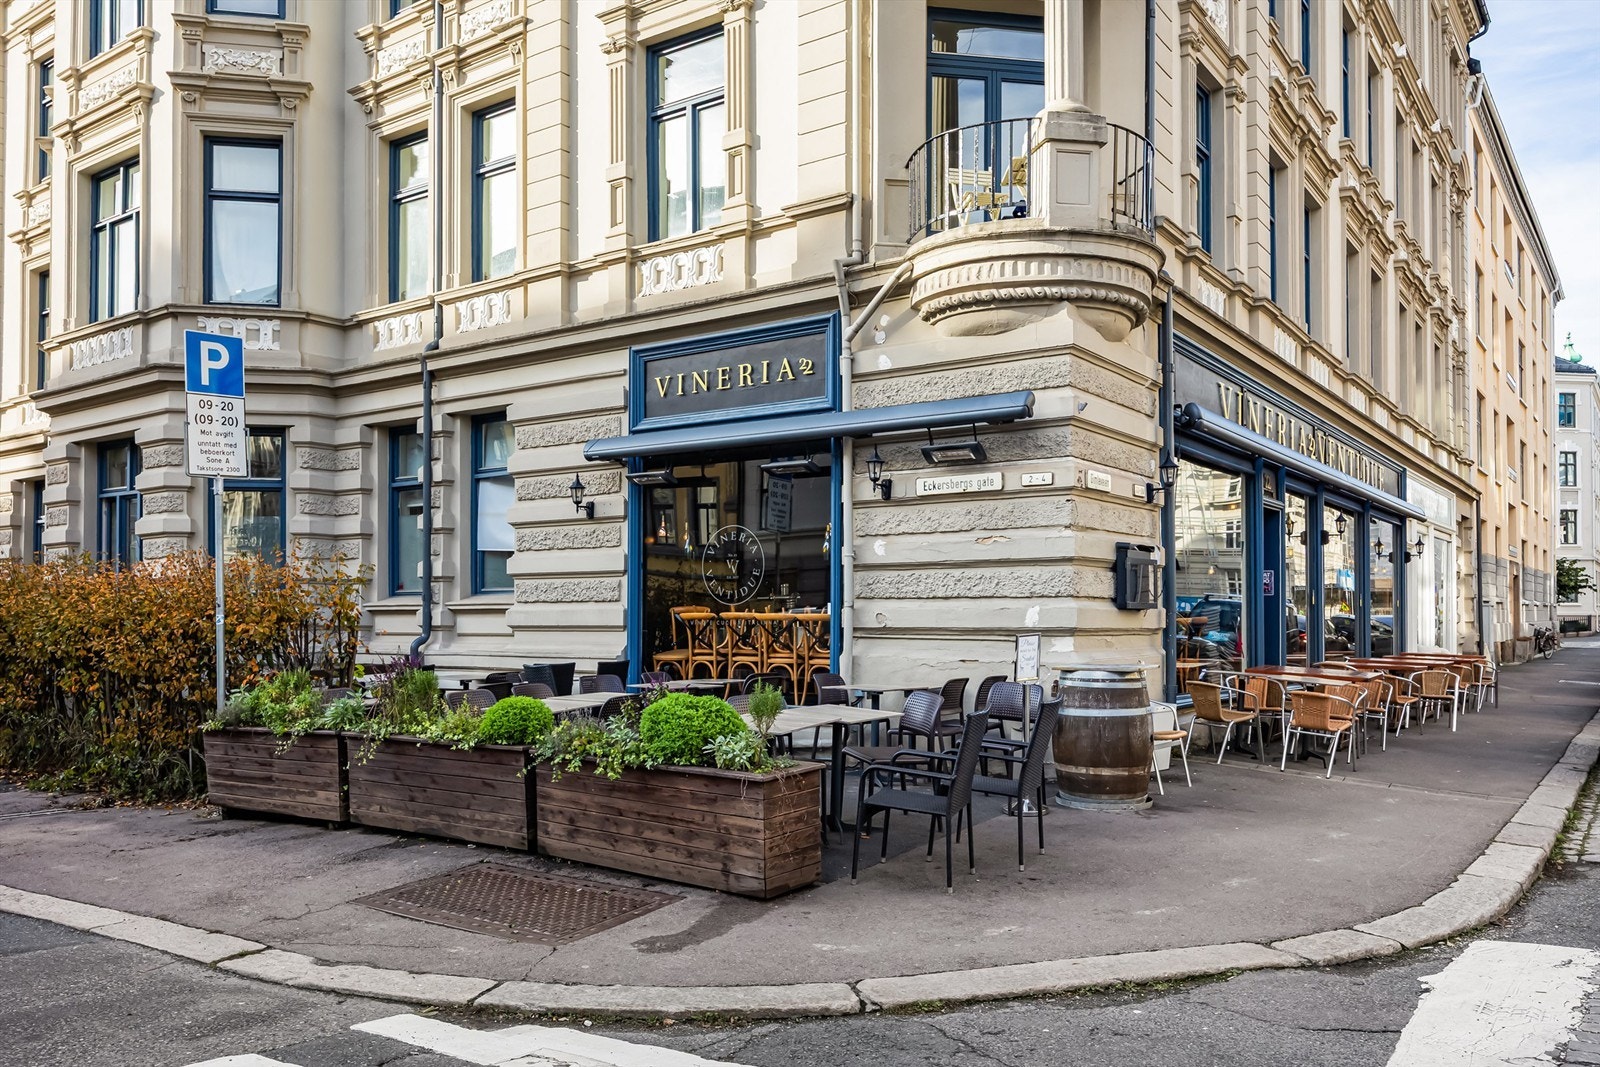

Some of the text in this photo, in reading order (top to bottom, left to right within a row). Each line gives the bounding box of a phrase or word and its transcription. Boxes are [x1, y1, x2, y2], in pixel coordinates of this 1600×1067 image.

[200, 340, 229, 386] P
[655, 357, 795, 398] VINERIA
[200, 448, 235, 456] beboerkort
[206, 456, 222, 464] Sone
[196, 464, 223, 472] Takstsone
[923, 477, 995, 491] Eckersbergs gate
[707, 531, 758, 555] VINERIA
[706, 568, 760, 600] VENTIDUE
